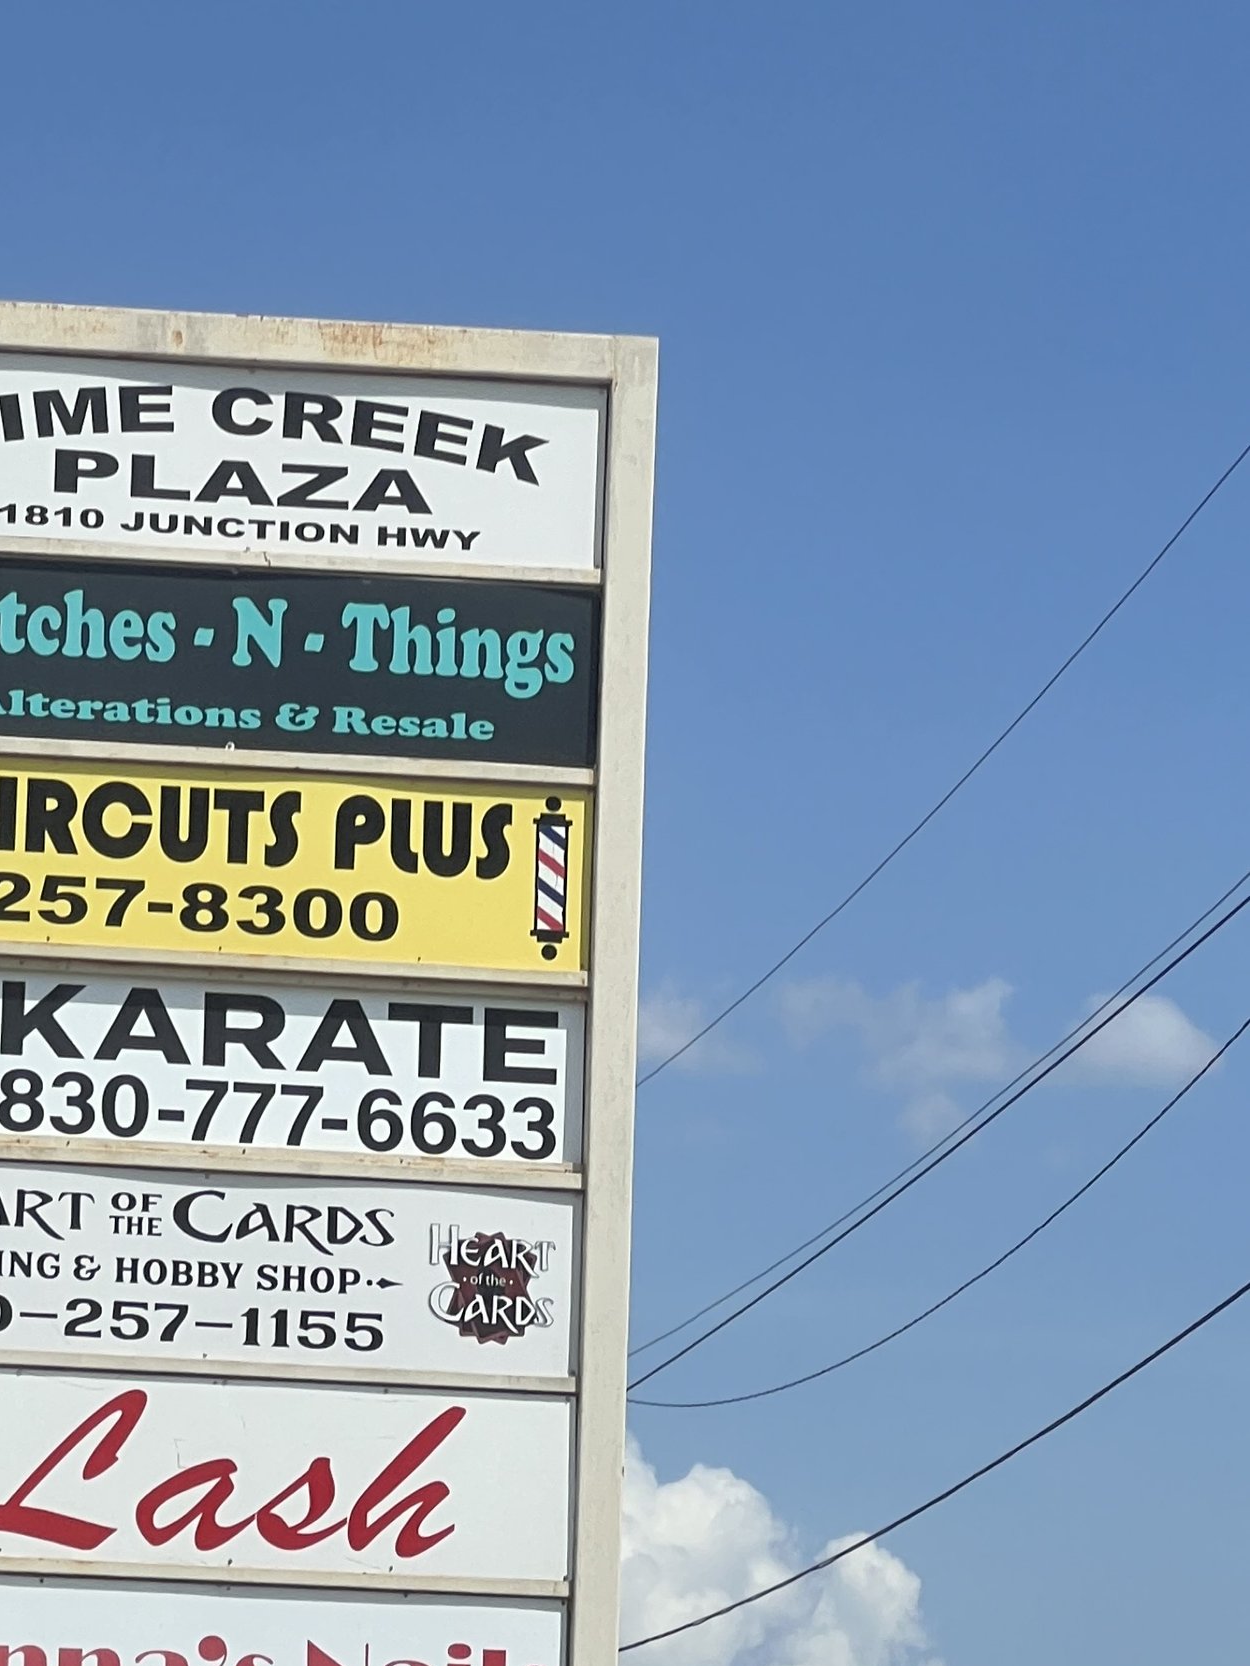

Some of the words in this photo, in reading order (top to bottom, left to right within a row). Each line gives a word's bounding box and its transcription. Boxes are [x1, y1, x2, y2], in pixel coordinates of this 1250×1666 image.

[211, 387, 549, 486] CREEK
[53, 449, 434, 515] PLAZA
[120, 511, 361, 545] JUNCTION
[377, 526, 482, 552] HWY
[231, 596, 288, 668] N
[342, 603, 575, 698] Things
[276, 703, 316, 731] &
[332, 706, 496, 743] Resale
[335, 793, 514, 881] PLUS
[0, 980, 559, 1086] KARATE
[109, 1214, 163, 1238] THE
[111, 1191, 162, 1213] OF
[172, 1190, 396, 1248] CARDS
[73, 1255, 100, 1282] &
[116, 1257, 240, 1291] HOBBY
[256, 1264, 362, 1294] SHOP
[430, 1223, 557, 1278] HEART
[470, 1273, 483, 1285] of
[486, 1273, 506, 1286] the
[428, 1281, 554, 1334] CARDS
